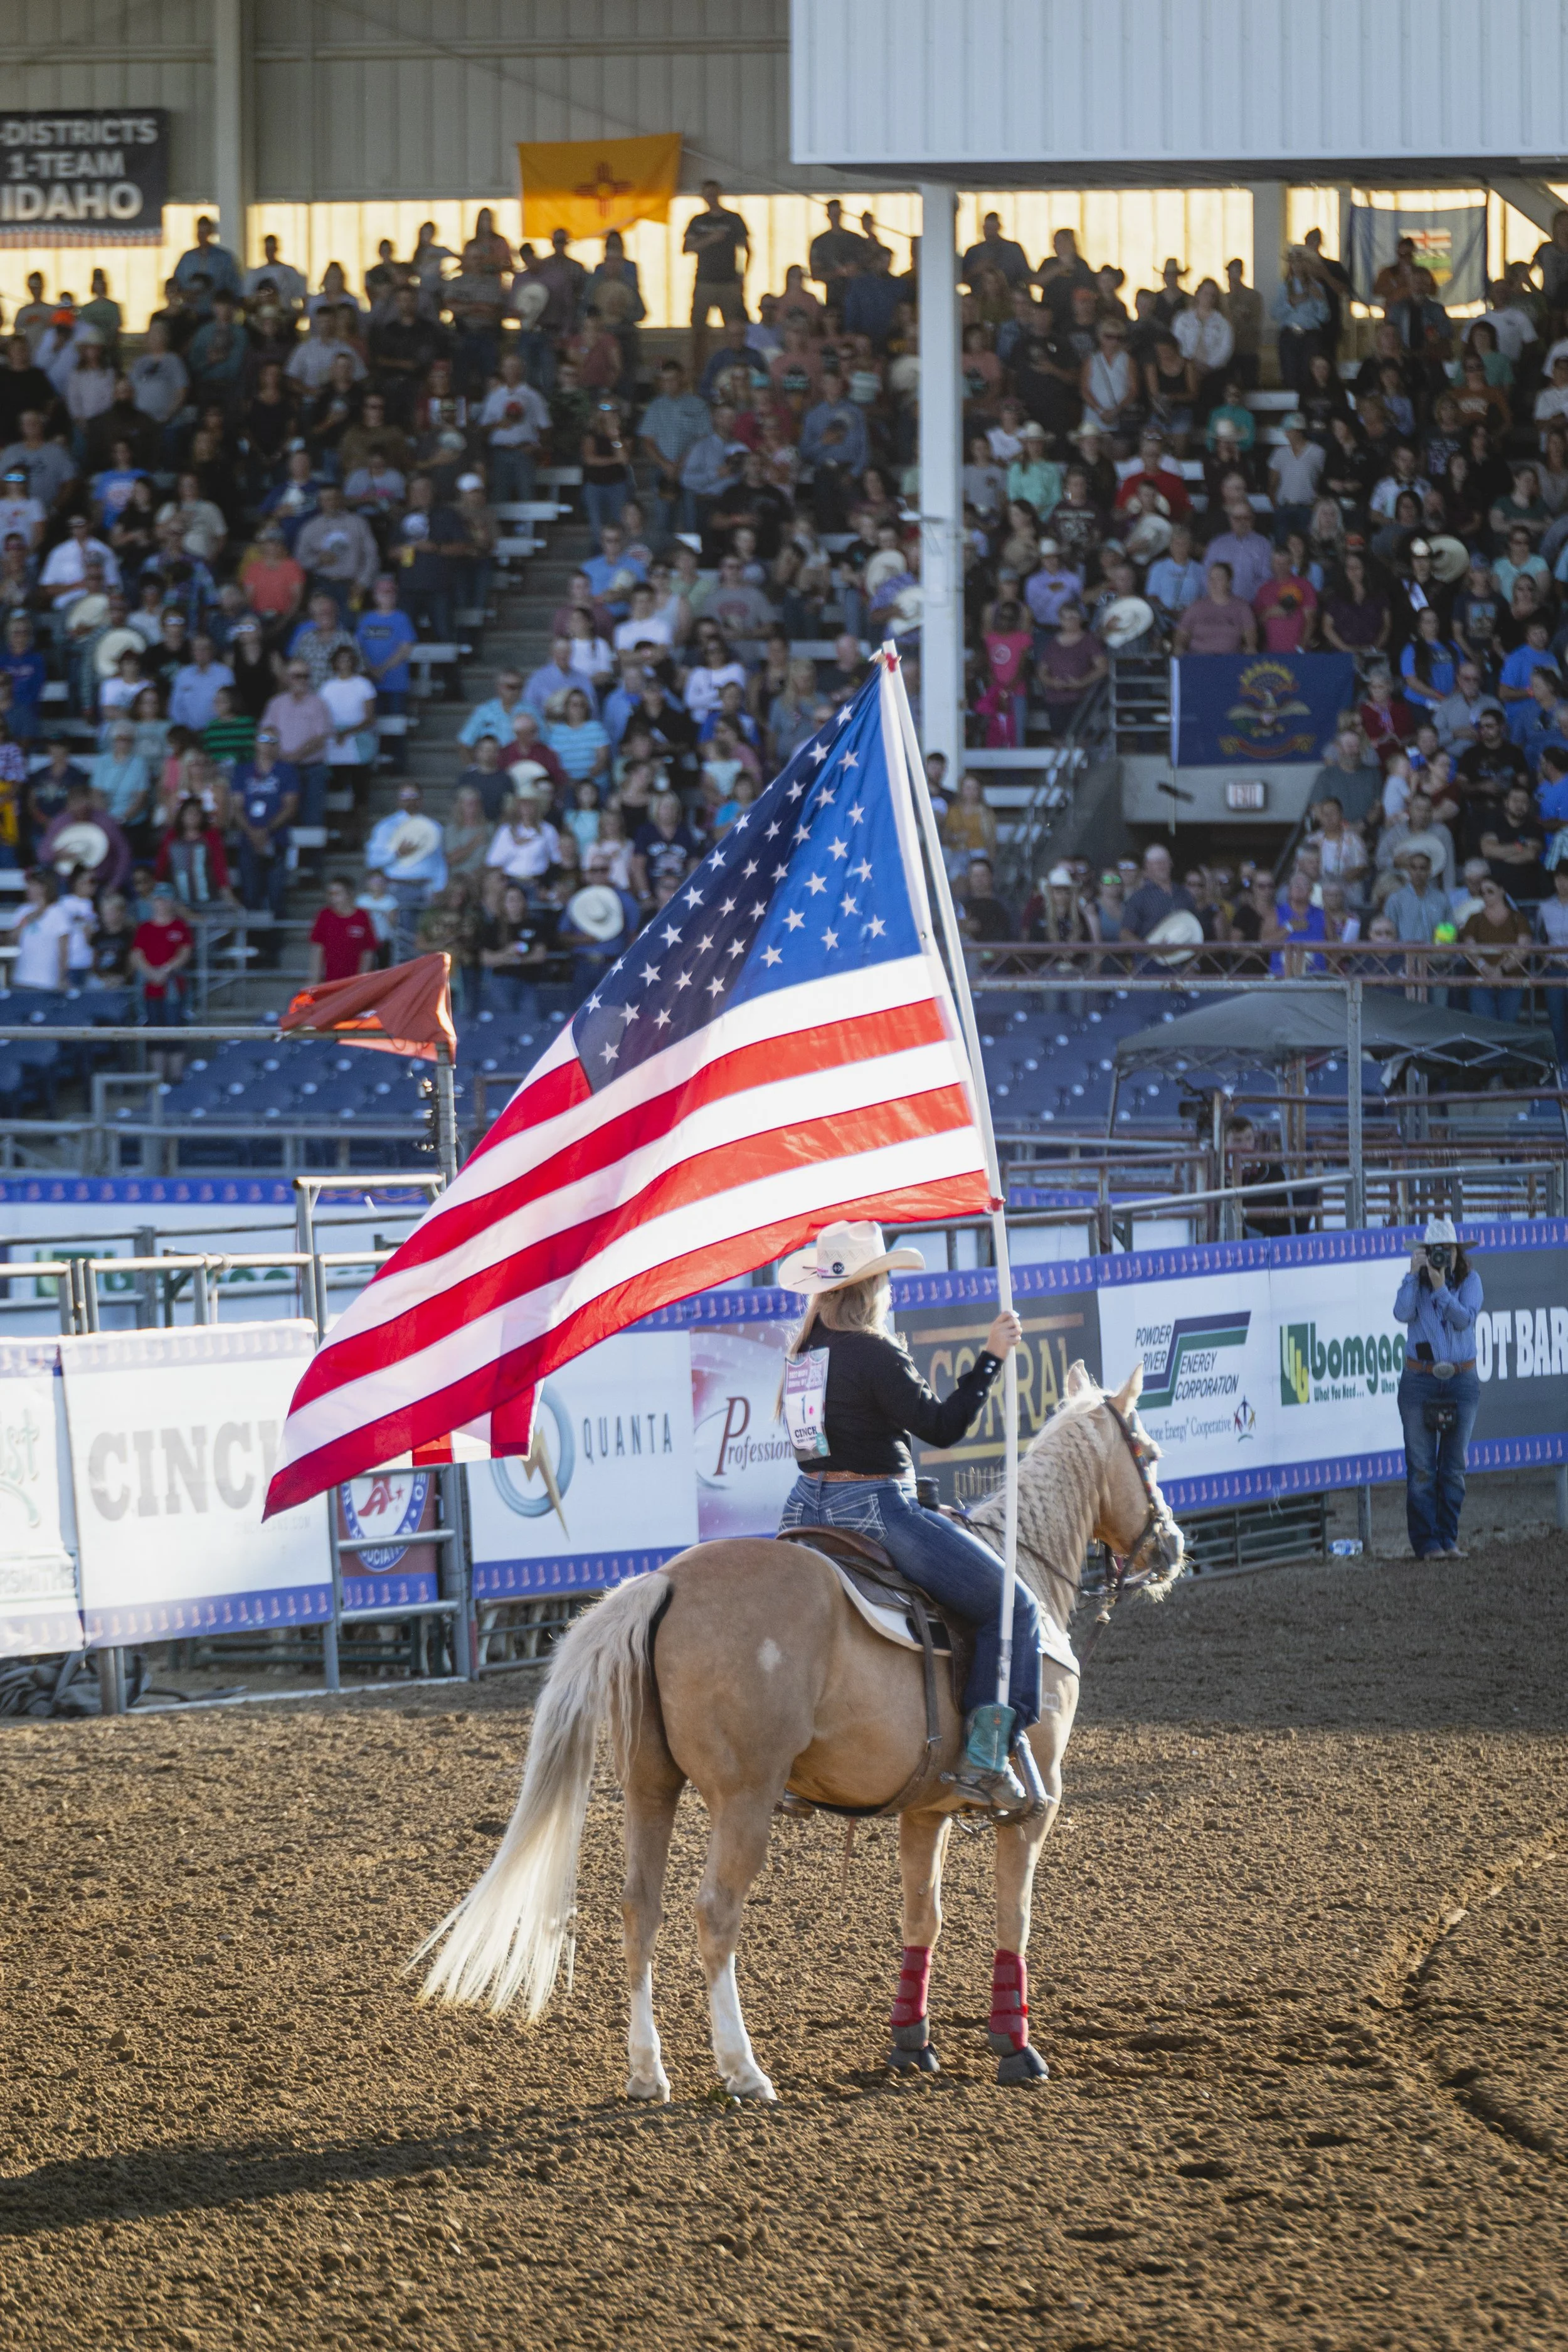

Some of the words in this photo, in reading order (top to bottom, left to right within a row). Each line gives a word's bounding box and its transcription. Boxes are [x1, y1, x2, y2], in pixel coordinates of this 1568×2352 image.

[7, 151, 125, 179] 1-TEAM
[0, 182, 144, 220] IDAHO
[1135, 1324, 1172, 1348] POWDER
[1474, 1310, 1512, 1383] OT
[1143, 1350, 1167, 1371] RIVER
[1180, 1350, 1217, 1375] ENERGY
[1175, 1374, 1239, 1401] CORPORATION
[1314, 1384, 1330, 1403] What
[1332, 1384, 1341, 1401] You
[1381, 1378, 1396, 1394] When
[801, 1394, 806, 1424] 1
[583, 1412, 672, 1465] QUANTA
[713, 1395, 796, 1476] Profession
[794, 1425, 818, 1438] CINCH
[1191, 1416, 1231, 1440] Cooperative
